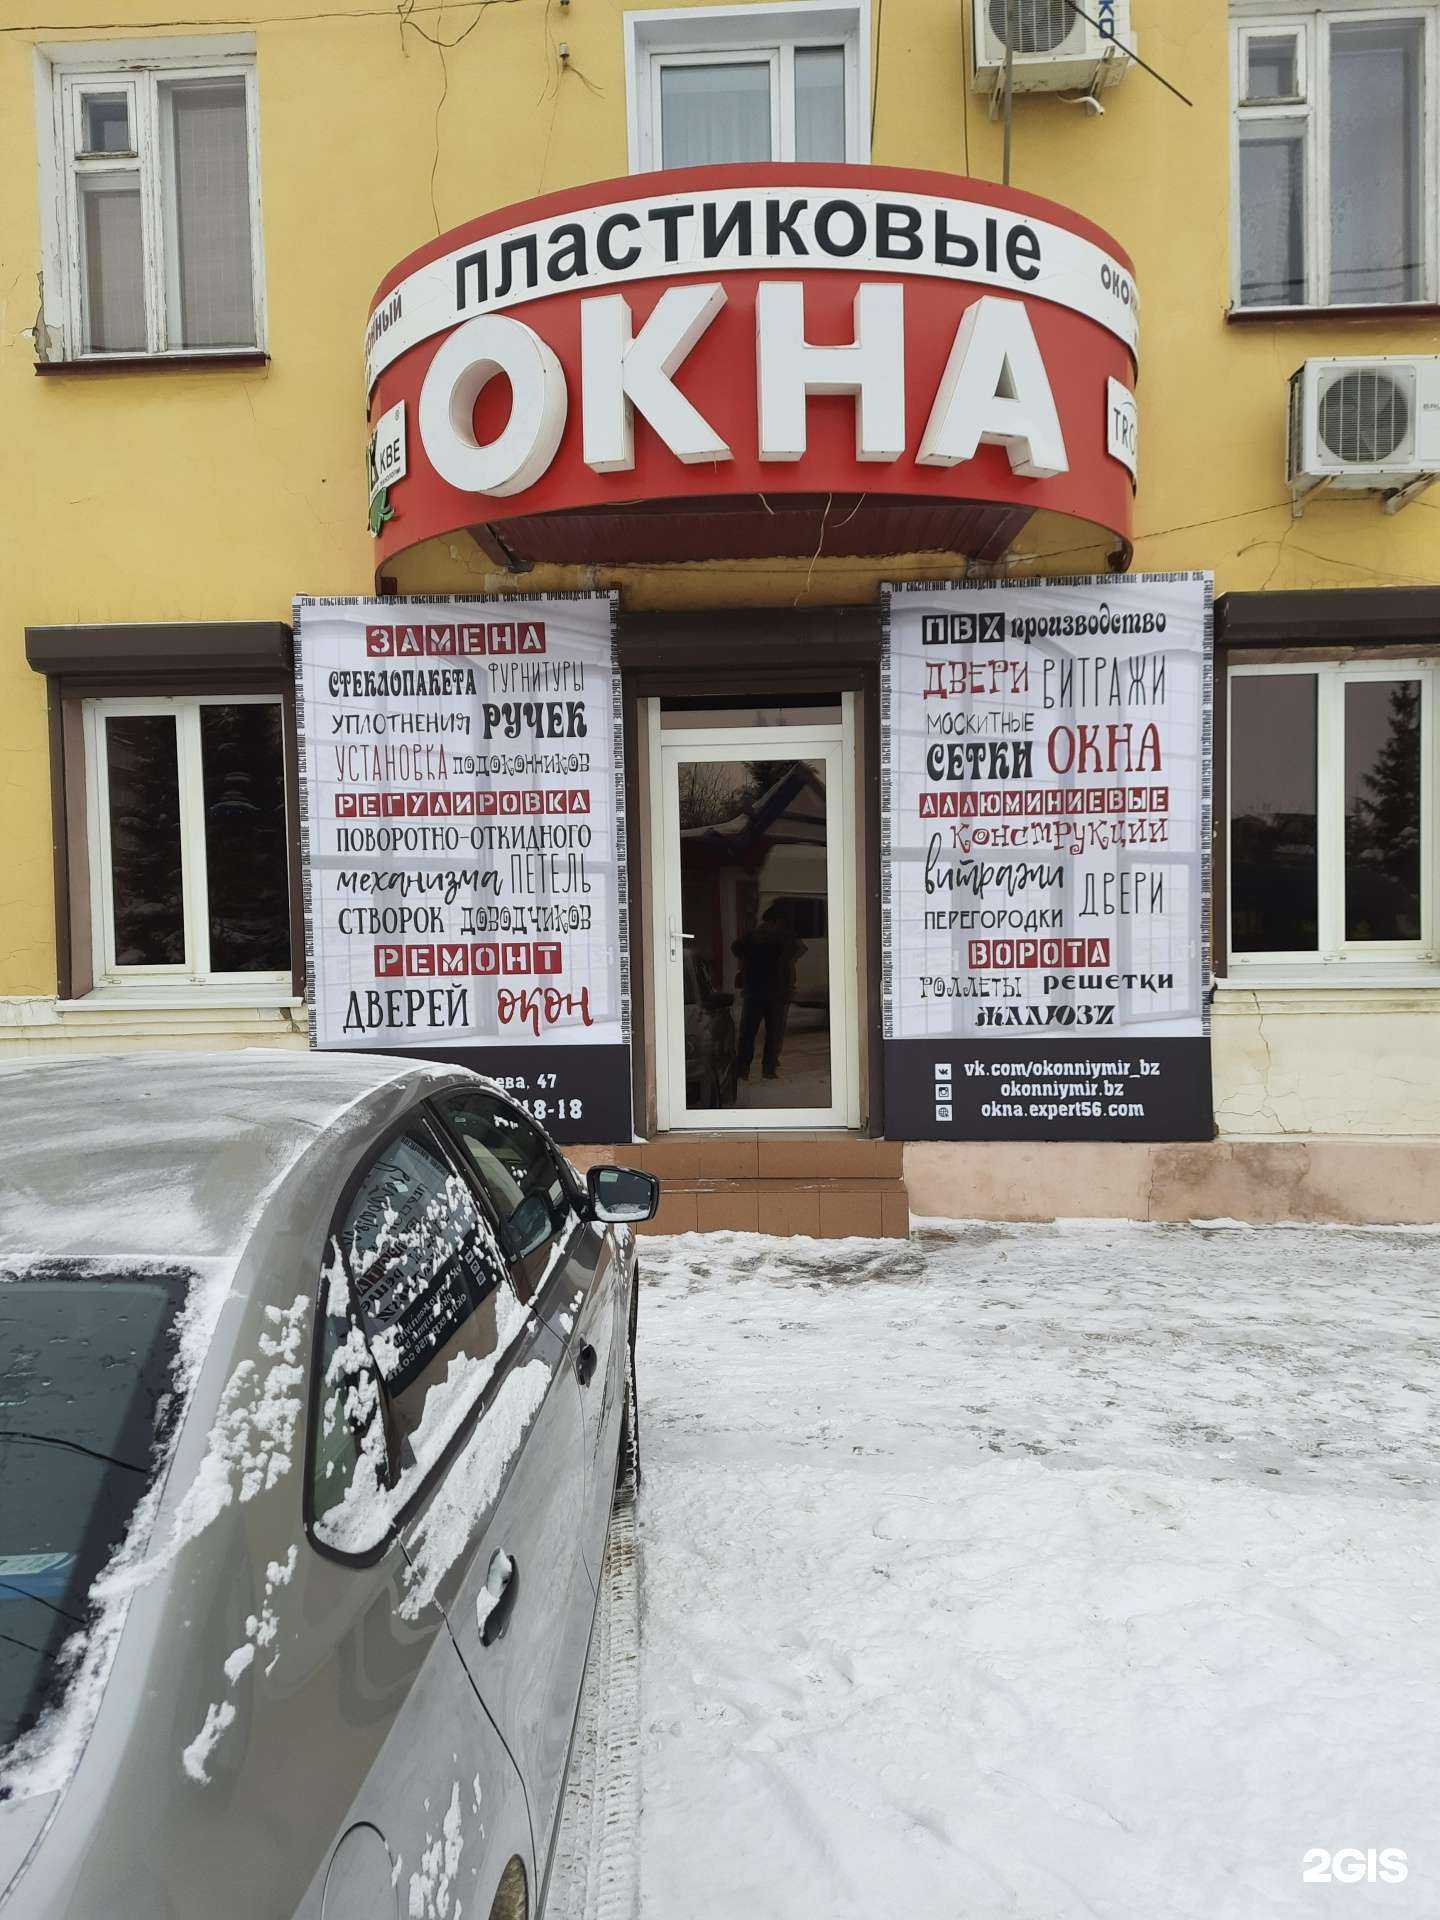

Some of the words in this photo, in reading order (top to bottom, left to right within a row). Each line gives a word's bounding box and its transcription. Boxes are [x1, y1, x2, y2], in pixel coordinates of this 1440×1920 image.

[456, 199, 1041, 311] пластиковые
[419, 281, 1069, 497] ОКНА
[367, 623, 545, 656] ЗАМЕНА
[922, 612, 1005, 645] ПВХ
[1010, 602, 1167, 645] производство
[328, 669, 477, 698] СТЕКЛОПАКЕТА
[488, 661, 584, 694] ФУРНИТУРЫ
[923, 660, 1029, 700] ДВЕРИ
[1043, 655, 1166, 709] ВИТРАЖИ
[482, 701, 588, 740] РУЧЕК
[927, 712, 1034, 736] МОСКИТНЫЕ
[335, 744, 448, 782] УСТАНОВКА
[453, 753, 590, 777] ПОДОКОННИКОВ
[926, 741, 1033, 782] СЕТКИ
[1047, 722, 1162, 774] ОКНА
[335, 790, 590, 817] РЕГУЛИРОВКА
[920, 786, 1168, 818] АЛЛЮМИНИЕВЫЕ
[336, 824, 592, 852] ПОВОРОТНО-ОТКИДНОГО
[336, 868, 505, 905] механизма
[510, 853, 592, 894] ПЕТЕЛЬ
[924, 831, 1065, 900] витражи
[1079, 871, 1164, 917] ДВЕРИ
[338, 906, 445, 935] СТВОРОК
[461, 904, 592, 936] ДОВОДЧИКОВ
[924, 909, 1063, 932] ПЕРЕГОРОДКИ
[374, 942, 562, 977] РЕМОНТ
[968, 938, 1110, 968] ВОРОТА
[920, 976, 1022, 998] РОЛЛЕТЫ
[1043, 974, 1174, 994] решетки
[343, 983, 470, 1033] ДВЕРЕЙ
[497, 986, 594, 1037] окон
[975, 1005, 1116, 1026] ЖАЛЮЗИ
[494, 1076, 530, 1091] ева,
[537, 1073, 557, 1089] 47
[964, 1060, 1160, 1079] vk.com/okonniymir_bz
[1001, 1081, 1124, 1100] okonniymir.bz
[981, 1101, 1144, 1120] okna.expert56.com
